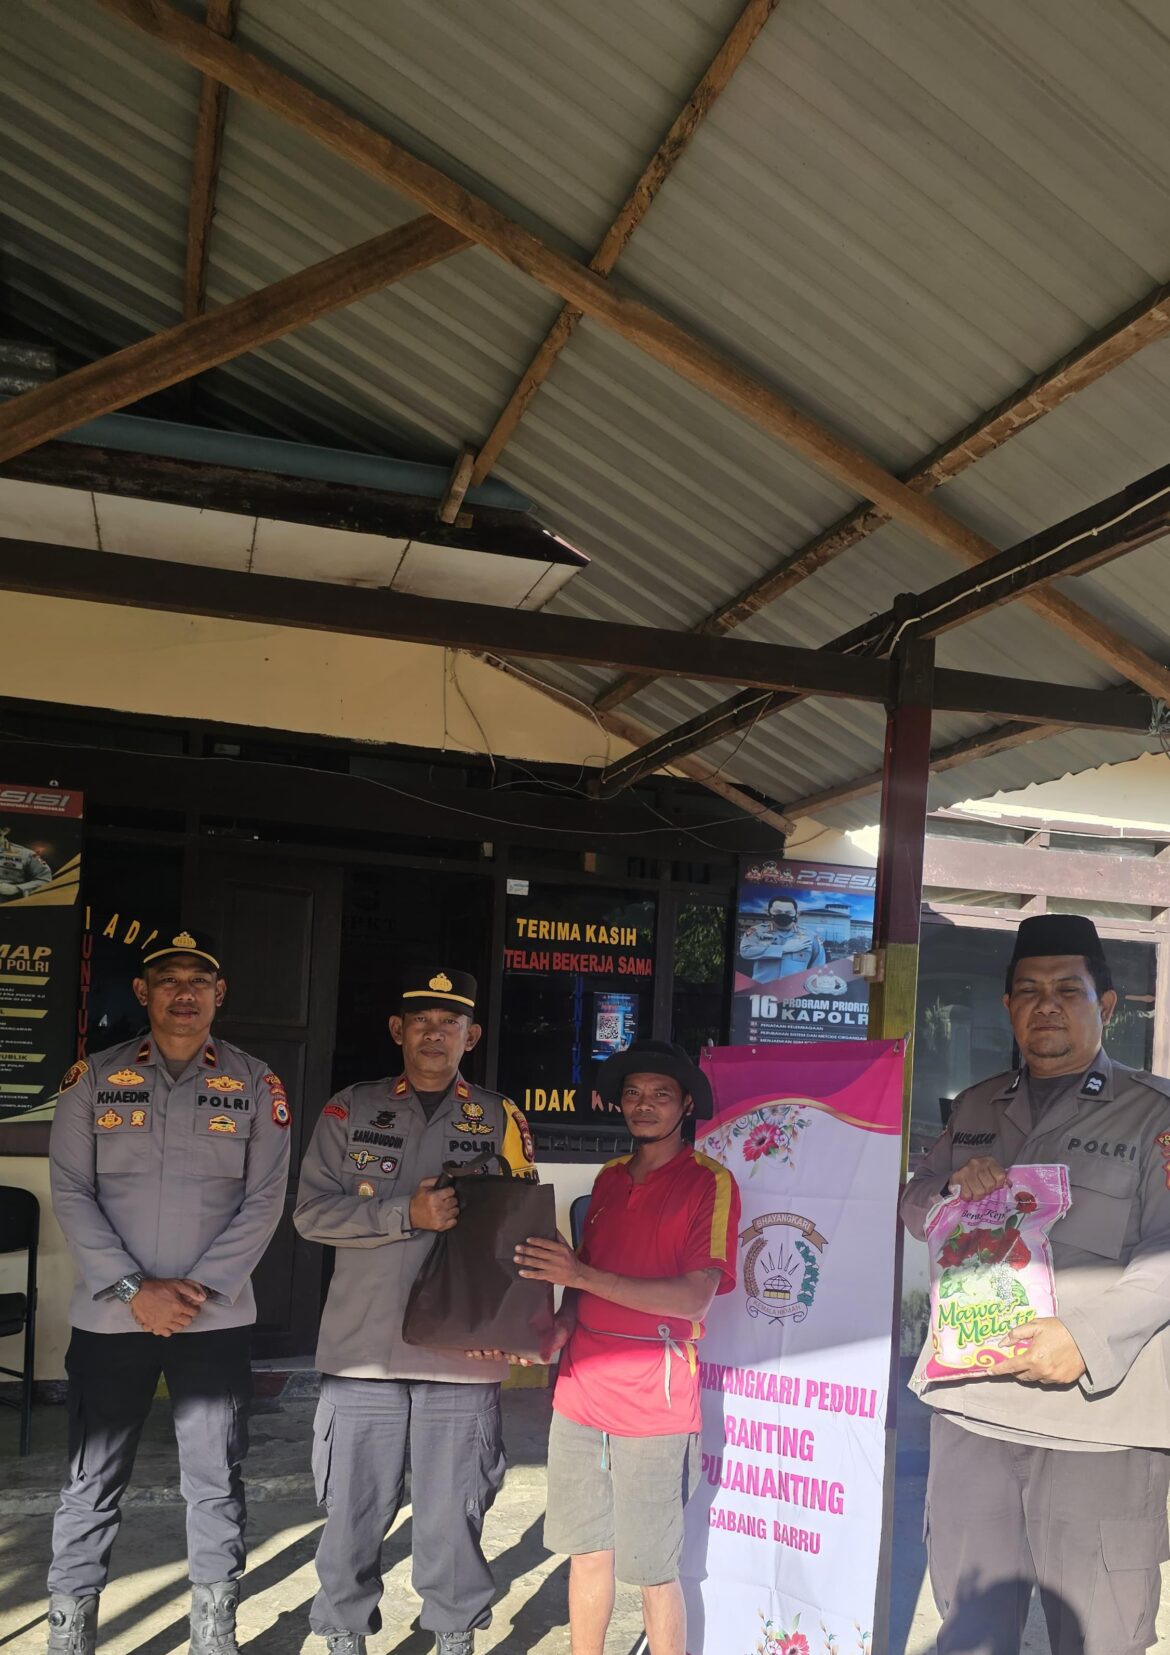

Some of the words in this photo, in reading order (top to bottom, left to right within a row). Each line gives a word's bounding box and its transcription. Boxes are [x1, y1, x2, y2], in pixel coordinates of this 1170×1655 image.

[797, 870, 876, 887] PRESI
[516, 918, 581, 942] TERIMA
[585, 924, 637, 947] KASIH
[6, 959, 49, 973] POLRI
[504, 949, 549, 971] TELAH
[552, 953, 614, 974] BEKERJA
[618, 957, 653, 977] SAMA
[77, 933, 94, 1060] UNTUK
[749, 994, 778, 1019] 16
[783, 997, 829, 1011] PROGRAM
[833, 1001, 870, 1013] PRIORIT
[97, 1091, 150, 1105] KHAEDIR
[198, 1096, 250, 1111] POLRI
[449, 1140, 496, 1154] POLRI
[1067, 1138, 1137, 1161] POLRI
[756, 1214, 812, 1231] BHAYANGKARI
[804, 1379, 878, 1419] PEDULI
[724, 1415, 815, 1462] RANTING
[708, 1507, 768, 1540] CABANG
[773, 1520, 821, 1555] BARRU
